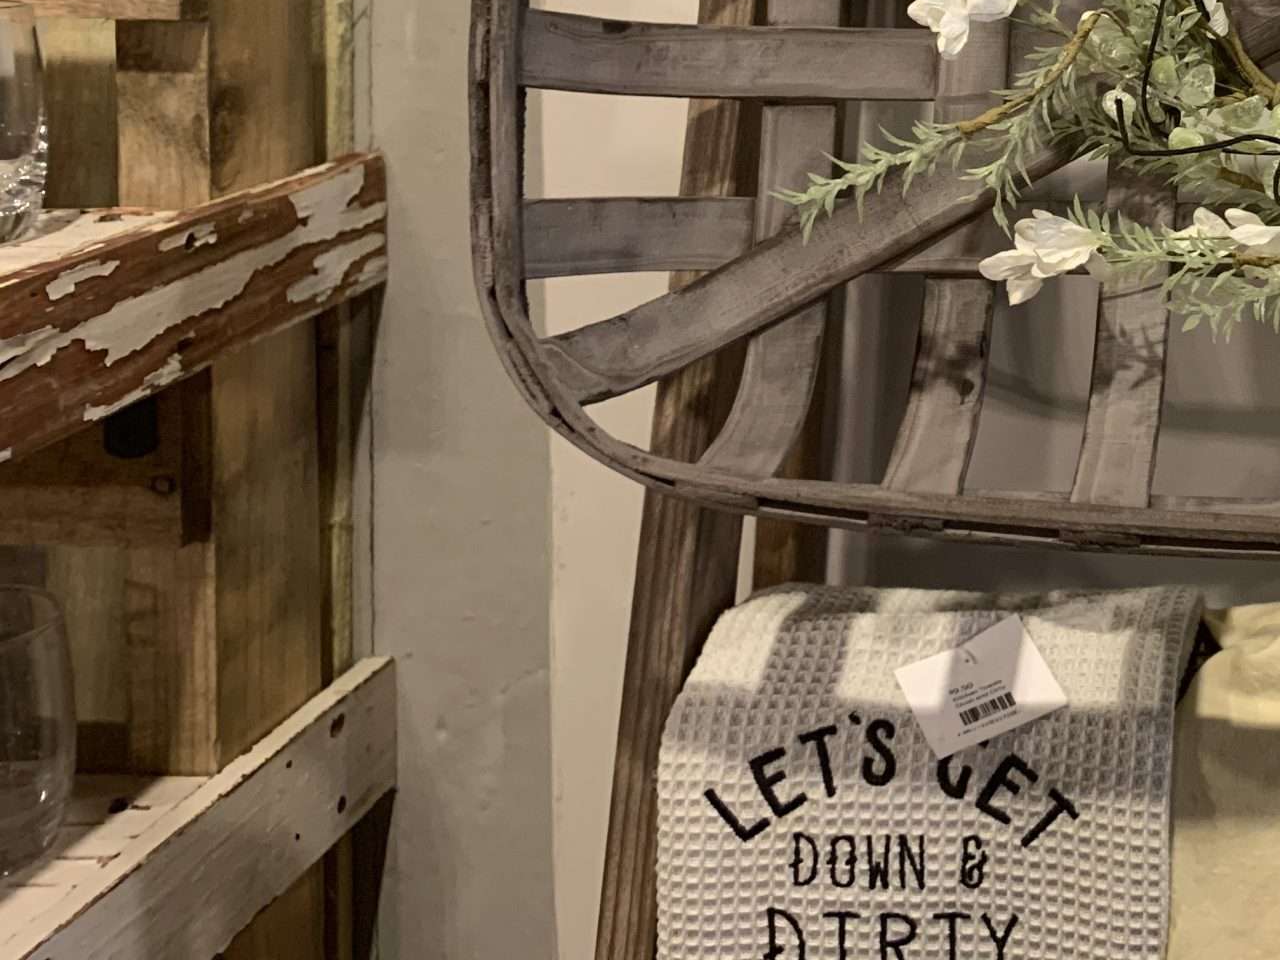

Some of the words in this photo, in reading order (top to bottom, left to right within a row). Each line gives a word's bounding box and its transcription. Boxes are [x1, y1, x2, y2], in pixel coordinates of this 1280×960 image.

[704, 712, 897, 843] LET'S
[788, 832, 926, 890] DOWN
[960, 834, 989, 890] &
[763, 907, 1019, 960] DIRTY
